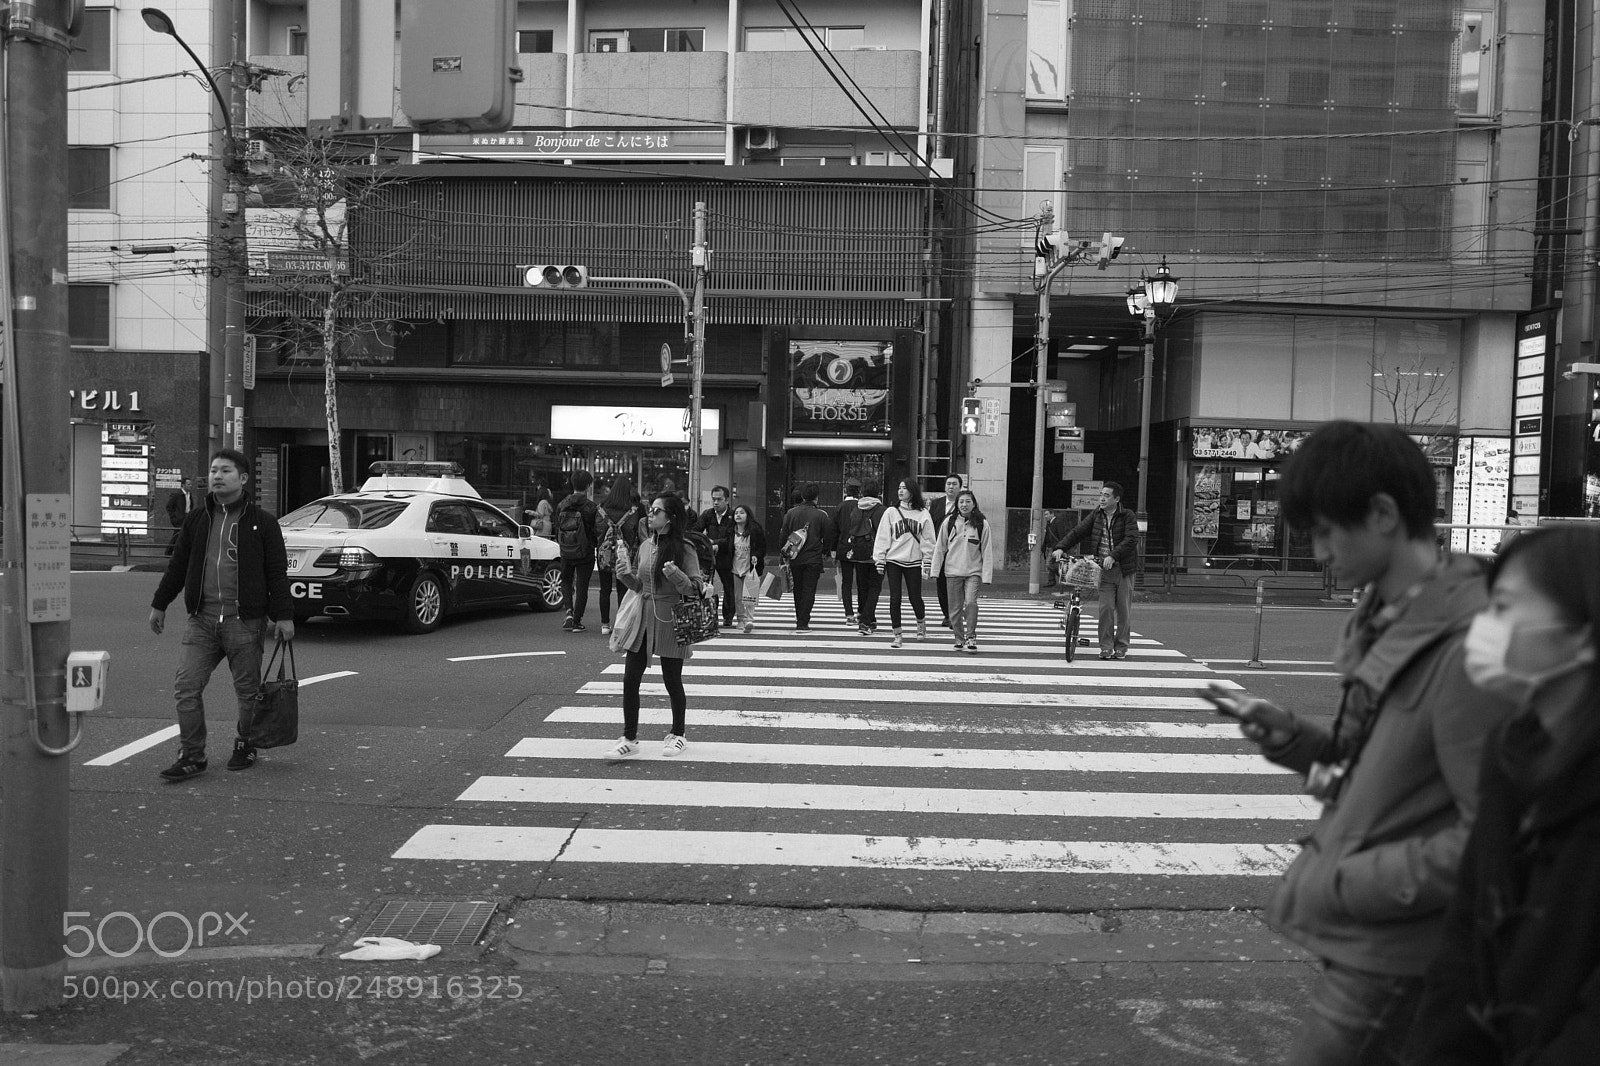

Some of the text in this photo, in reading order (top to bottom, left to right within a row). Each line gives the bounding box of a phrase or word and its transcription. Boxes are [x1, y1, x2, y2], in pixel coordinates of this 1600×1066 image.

[472, 137, 524, 146] 米ぬか酵素浴
[534, 135, 669, 153] Bonjour de こんにちは
[301, 167, 335, 178] 米か
[69, 390, 141, 411] ビル1
[810, 406, 867, 420] HORSE
[450, 542, 514, 557] 警視庁
[451, 565, 514, 579] POLICE
[290, 582, 323, 599] CE
